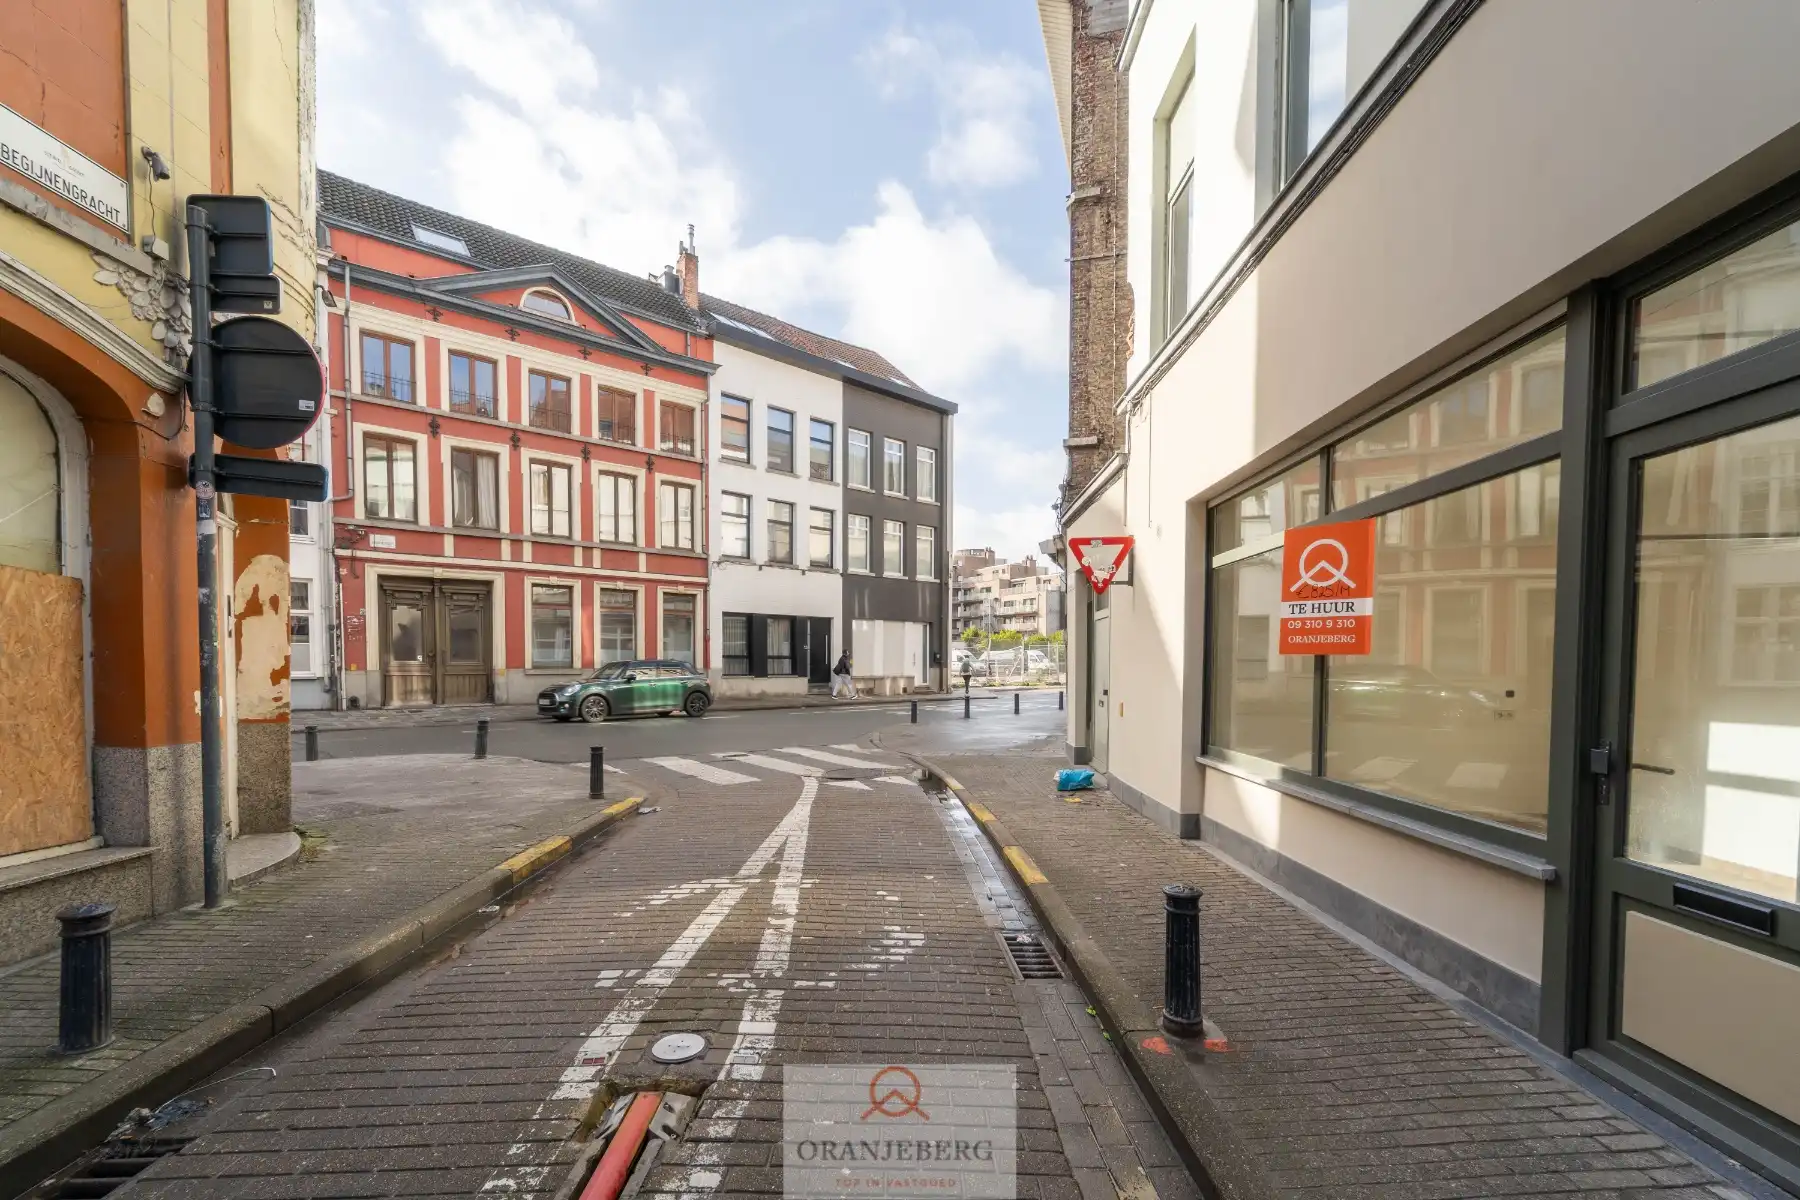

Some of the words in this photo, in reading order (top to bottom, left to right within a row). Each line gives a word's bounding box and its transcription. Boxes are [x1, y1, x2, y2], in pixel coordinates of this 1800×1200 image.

[0, 142, 121, 223] BEGIJNENGRACHT
[1289, 603, 1307, 615] TE
[1311, 601, 1355, 614] HUUR
[1288, 620, 1302, 628] 09
[1305, 620, 1322, 628] 310
[1326, 619, 1333, 628] 9
[1336, 619, 1356, 628] 310
[1288, 634, 1356, 644] ORANJEBERG
